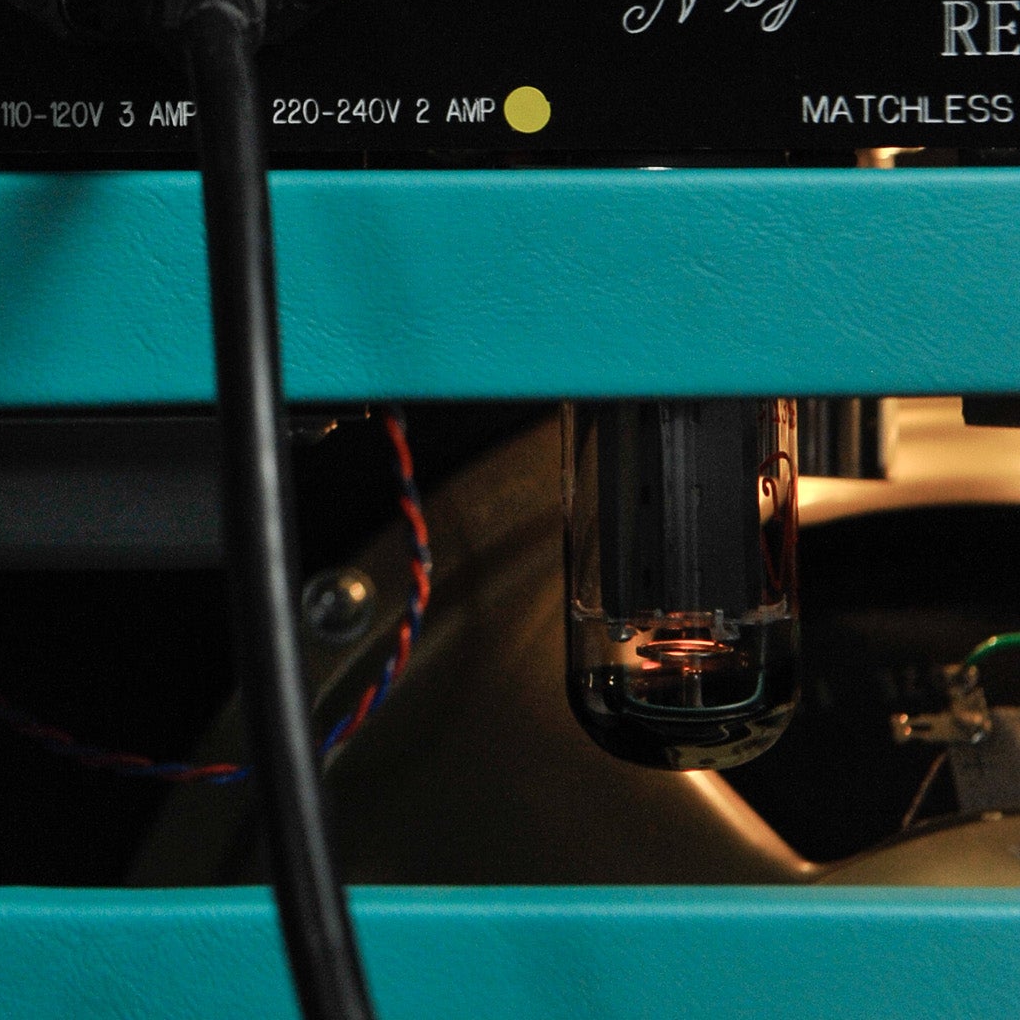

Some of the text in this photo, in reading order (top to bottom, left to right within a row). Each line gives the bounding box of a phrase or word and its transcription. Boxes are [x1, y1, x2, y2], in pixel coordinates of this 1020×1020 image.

[940, 0, 1020, 57] RE
[1, 101, 104, 128] 110-120V
[119, 101, 135, 128] 3
[272, 97, 496, 125] 220-240V 2 AMP
[802, 94, 1015, 124] MATCHLESS
